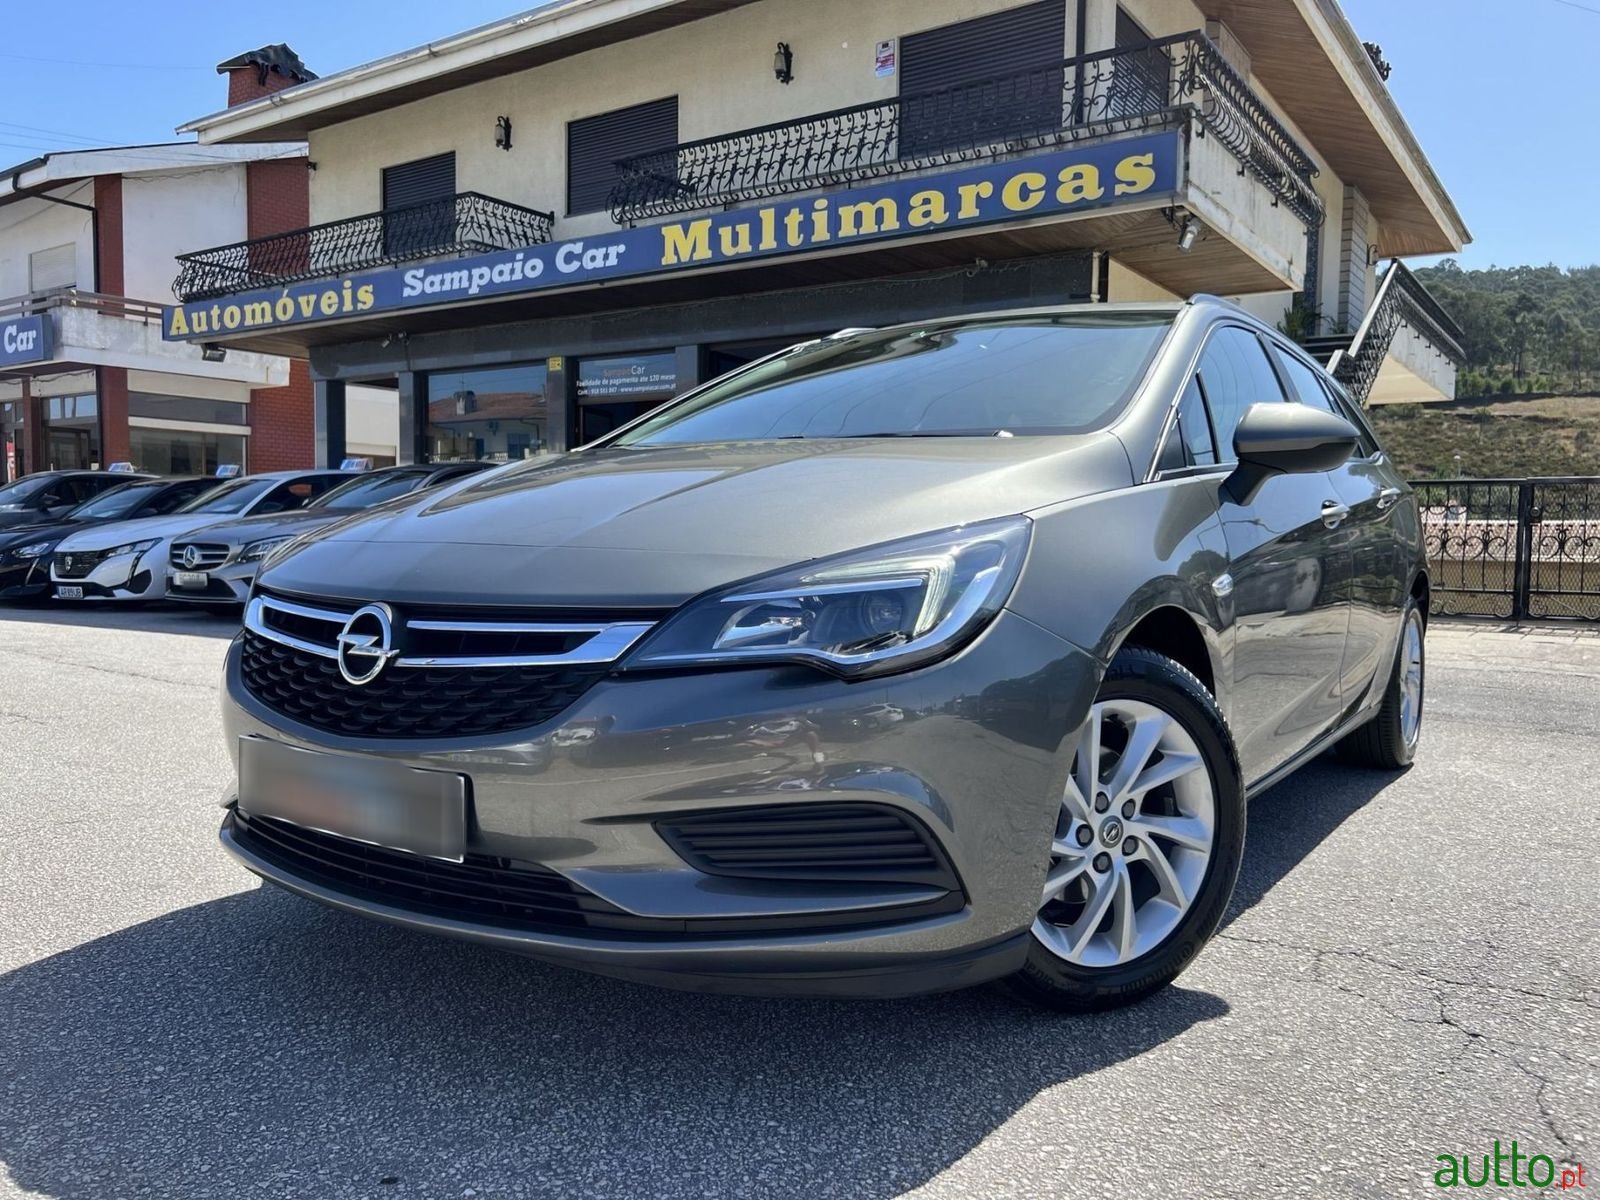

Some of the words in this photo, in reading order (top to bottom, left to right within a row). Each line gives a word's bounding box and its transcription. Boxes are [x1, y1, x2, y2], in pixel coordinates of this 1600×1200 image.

[169, 280, 375, 337] Automóveis
[402, 252, 544, 297] Sampaio
[555, 241, 627, 273] Car
[660, 154, 1156, 265] Multimarcas
[3, 324, 37, 354] Car
